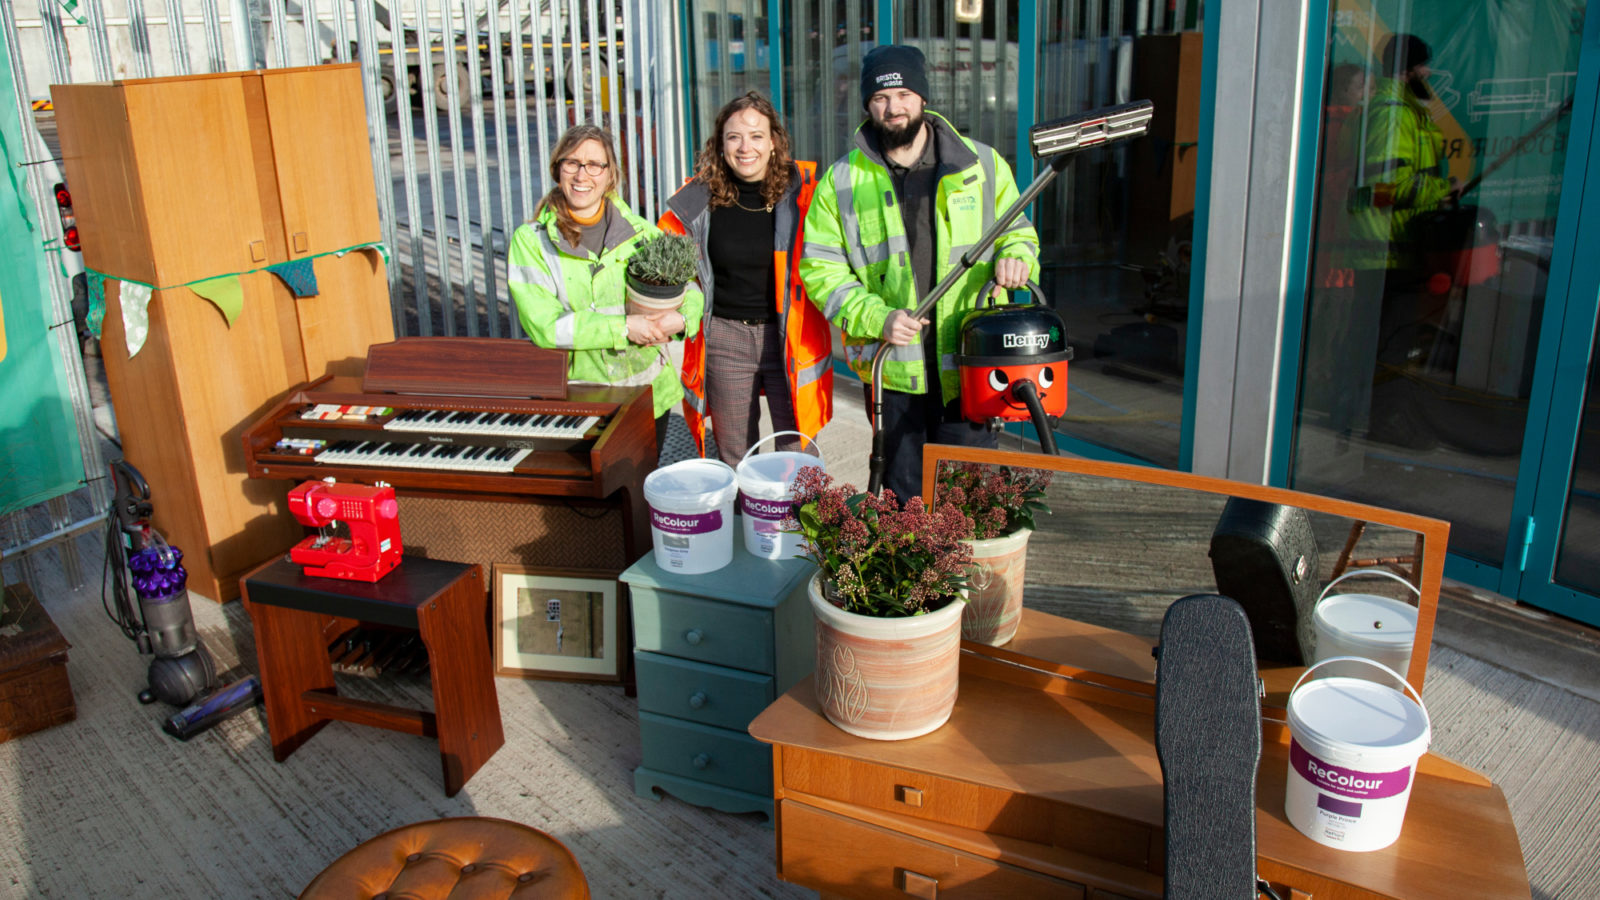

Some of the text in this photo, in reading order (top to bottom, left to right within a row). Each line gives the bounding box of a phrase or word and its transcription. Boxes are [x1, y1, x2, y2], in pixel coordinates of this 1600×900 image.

[876, 72, 904, 84] BRISTOL
[1003, 333, 1050, 349] Henry
[744, 499, 790, 514] ReColour
[653, 512, 699, 527] ReColour
[1308, 760, 1383, 789] ReColour
[1320, 810, 1338, 821] Purple
